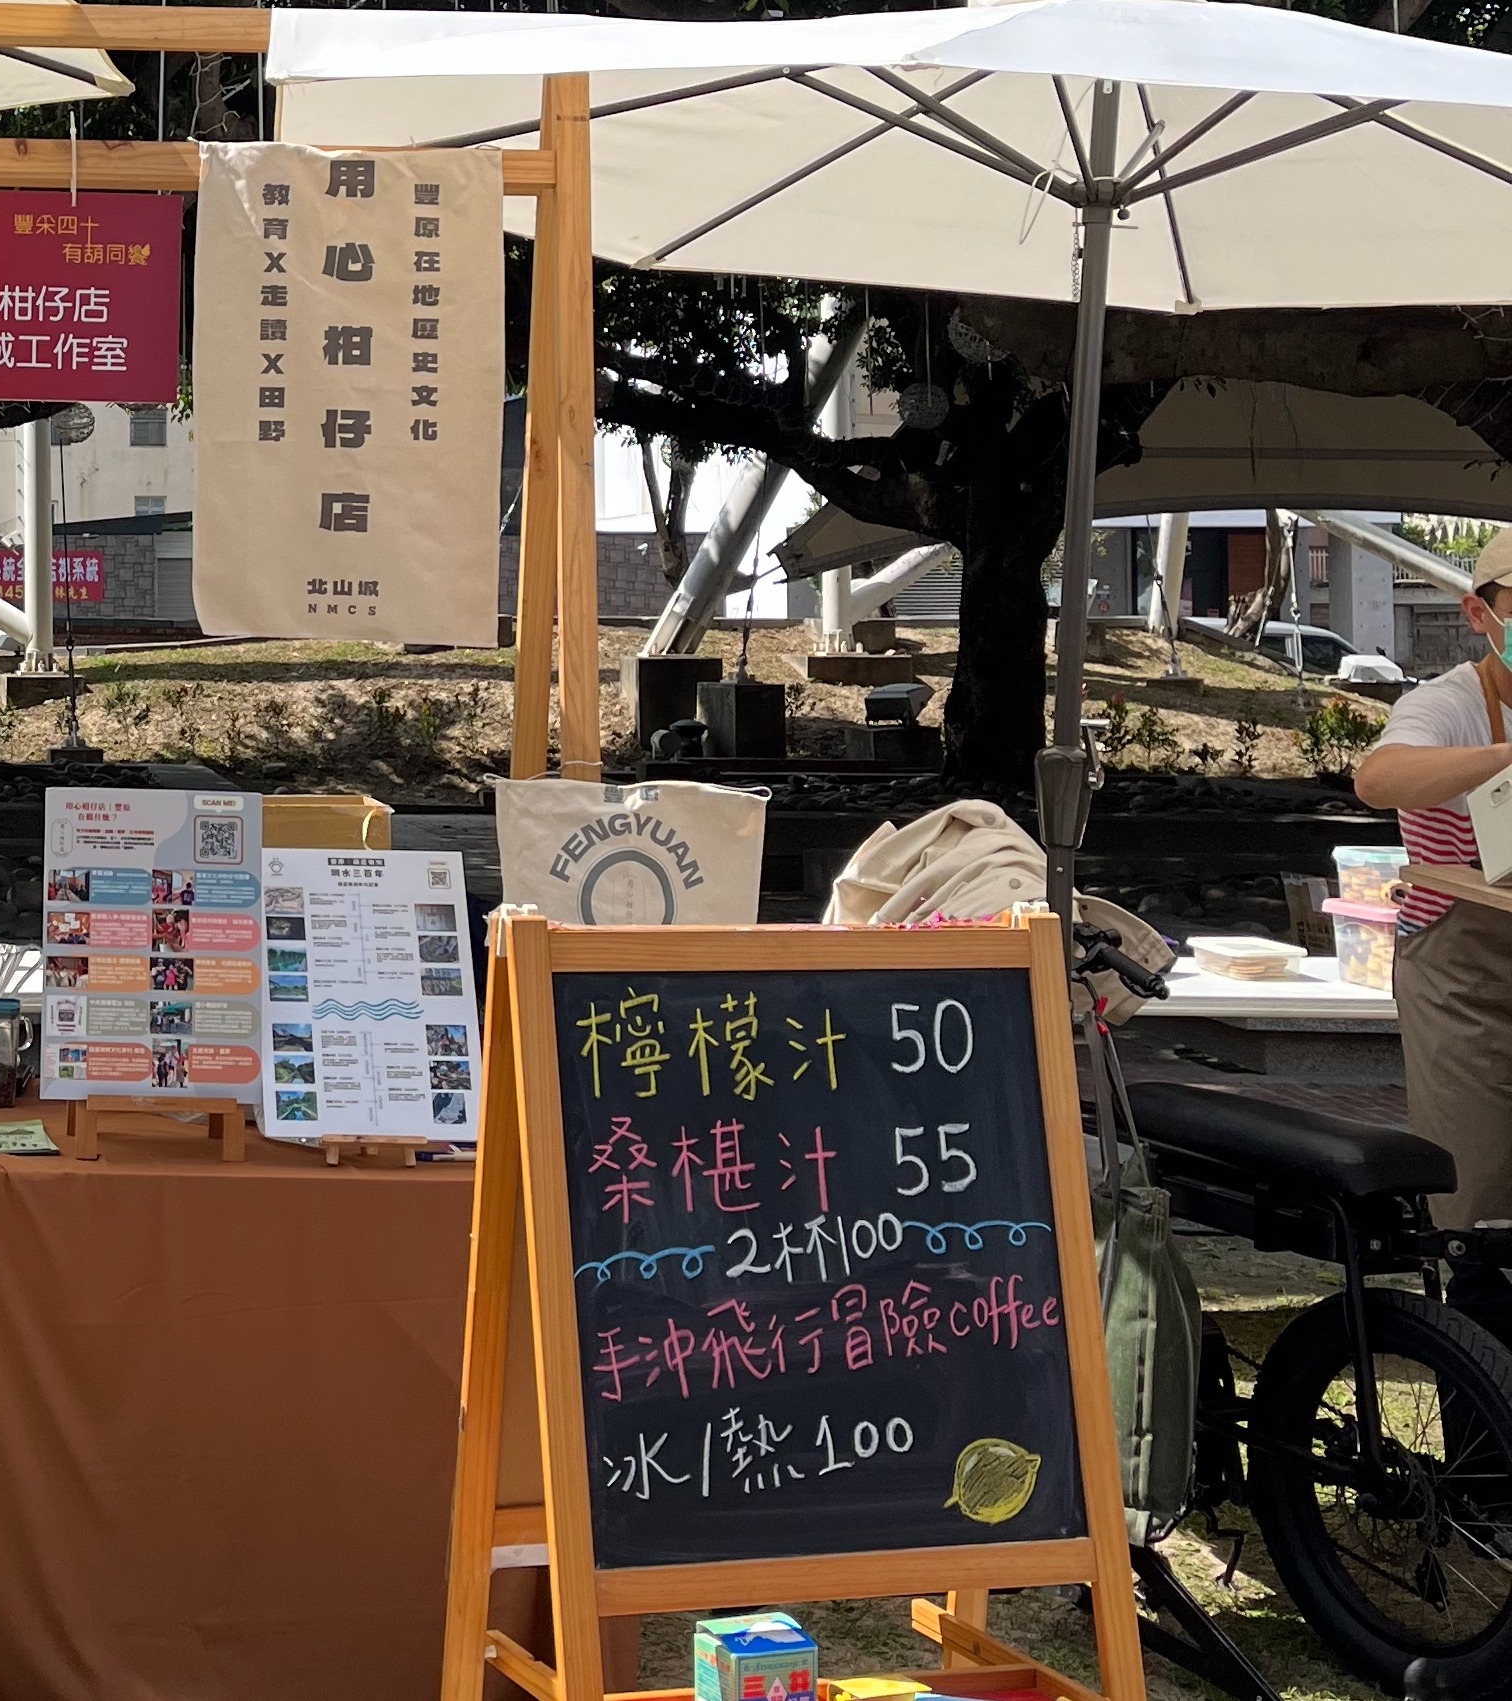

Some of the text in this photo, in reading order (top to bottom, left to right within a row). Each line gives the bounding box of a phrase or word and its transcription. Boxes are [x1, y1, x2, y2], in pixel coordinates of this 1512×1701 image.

[61, 242, 151, 266] 有葫同饗
[319, 159, 376, 533] 用心柑仔店
[409, 183, 441, 442] 豐原在地歷史文化
[306, 578, 380, 599] 北山城
[548, 811, 705, 891] FENGYUAN
[574, 986, 975, 1102] 檸檬汁 50
[587, 1115, 978, 1225] 桑椹汁 55
